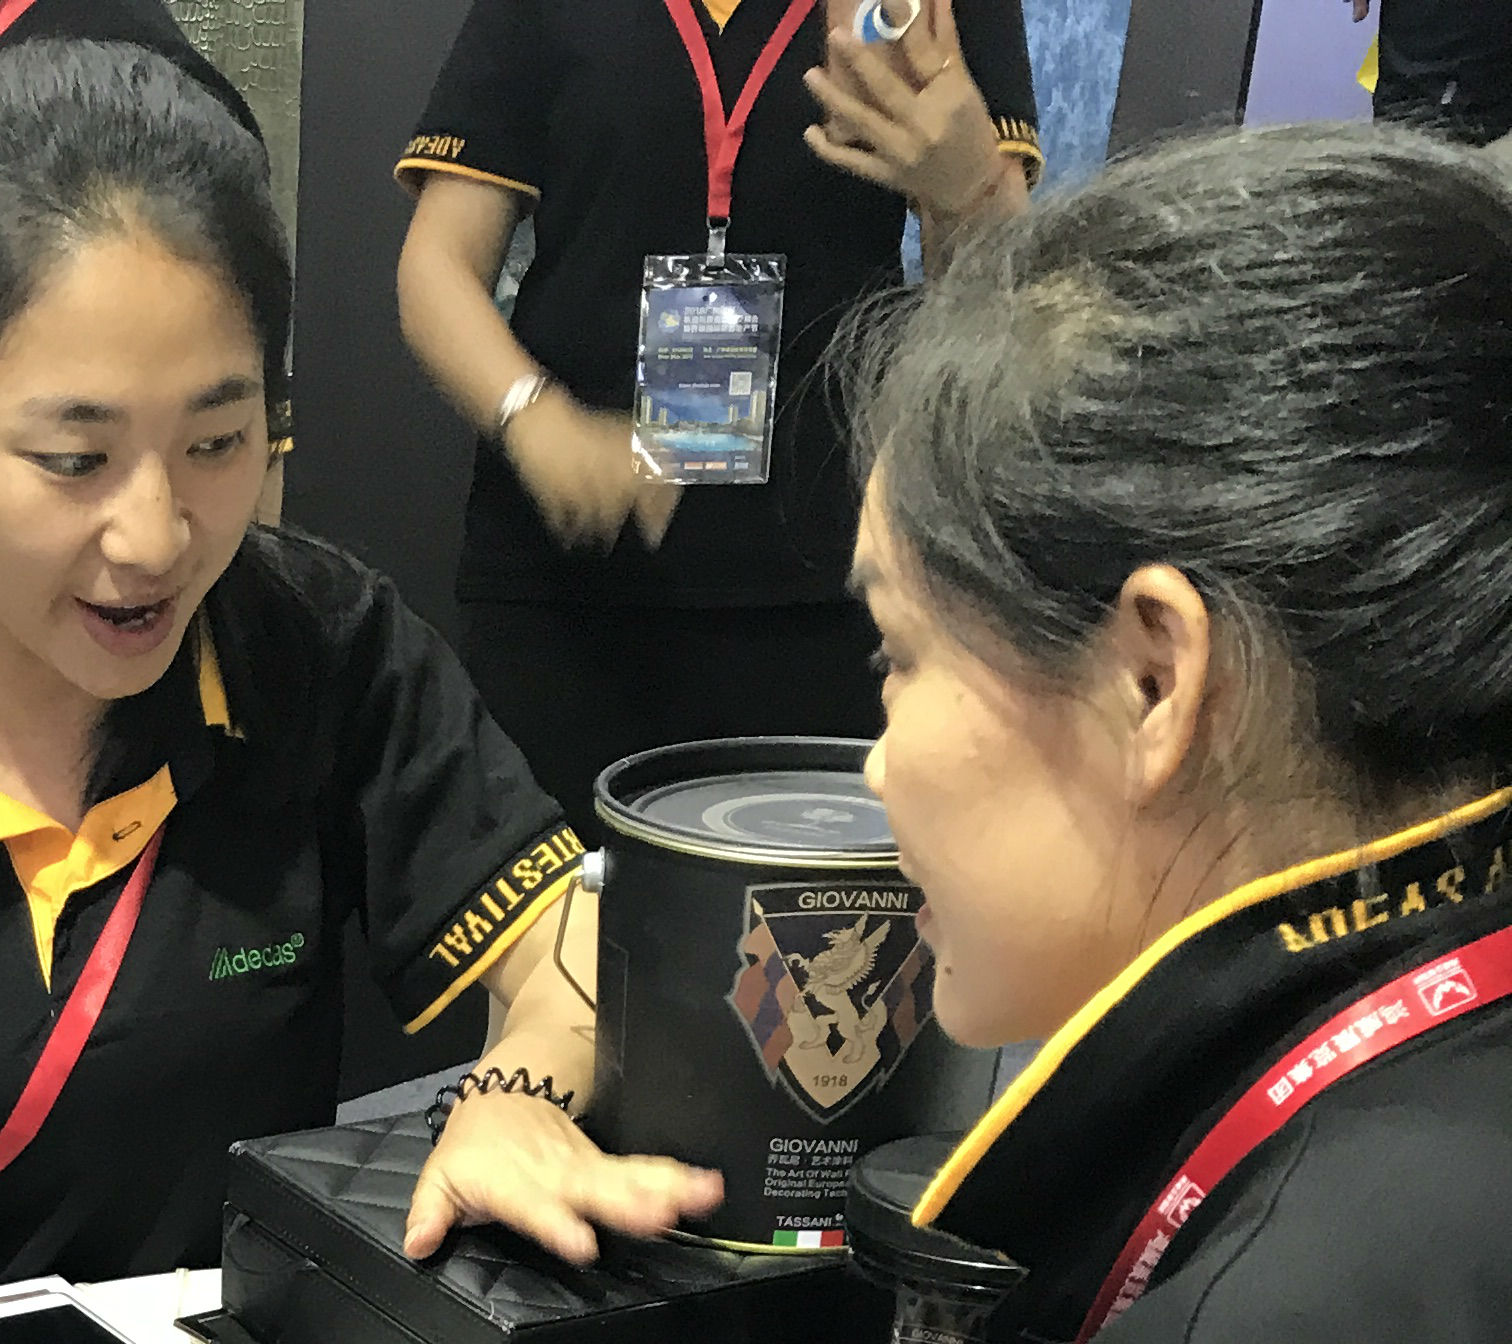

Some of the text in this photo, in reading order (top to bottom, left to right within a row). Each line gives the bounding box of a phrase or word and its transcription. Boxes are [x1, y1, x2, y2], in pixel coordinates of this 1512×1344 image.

[798, 890, 909, 910] GIOVANNI
[812, 1073, 849, 1089] 1918
[769, 1137, 860, 1153] GIOVANNI
[766, 1167, 786, 1178] The
[787, 1168, 804, 1178] Art
[764, 1177, 807, 1189] Original
[763, 1187, 821, 1199] Decorating
[776, 1215, 833, 1228] TASSANI
